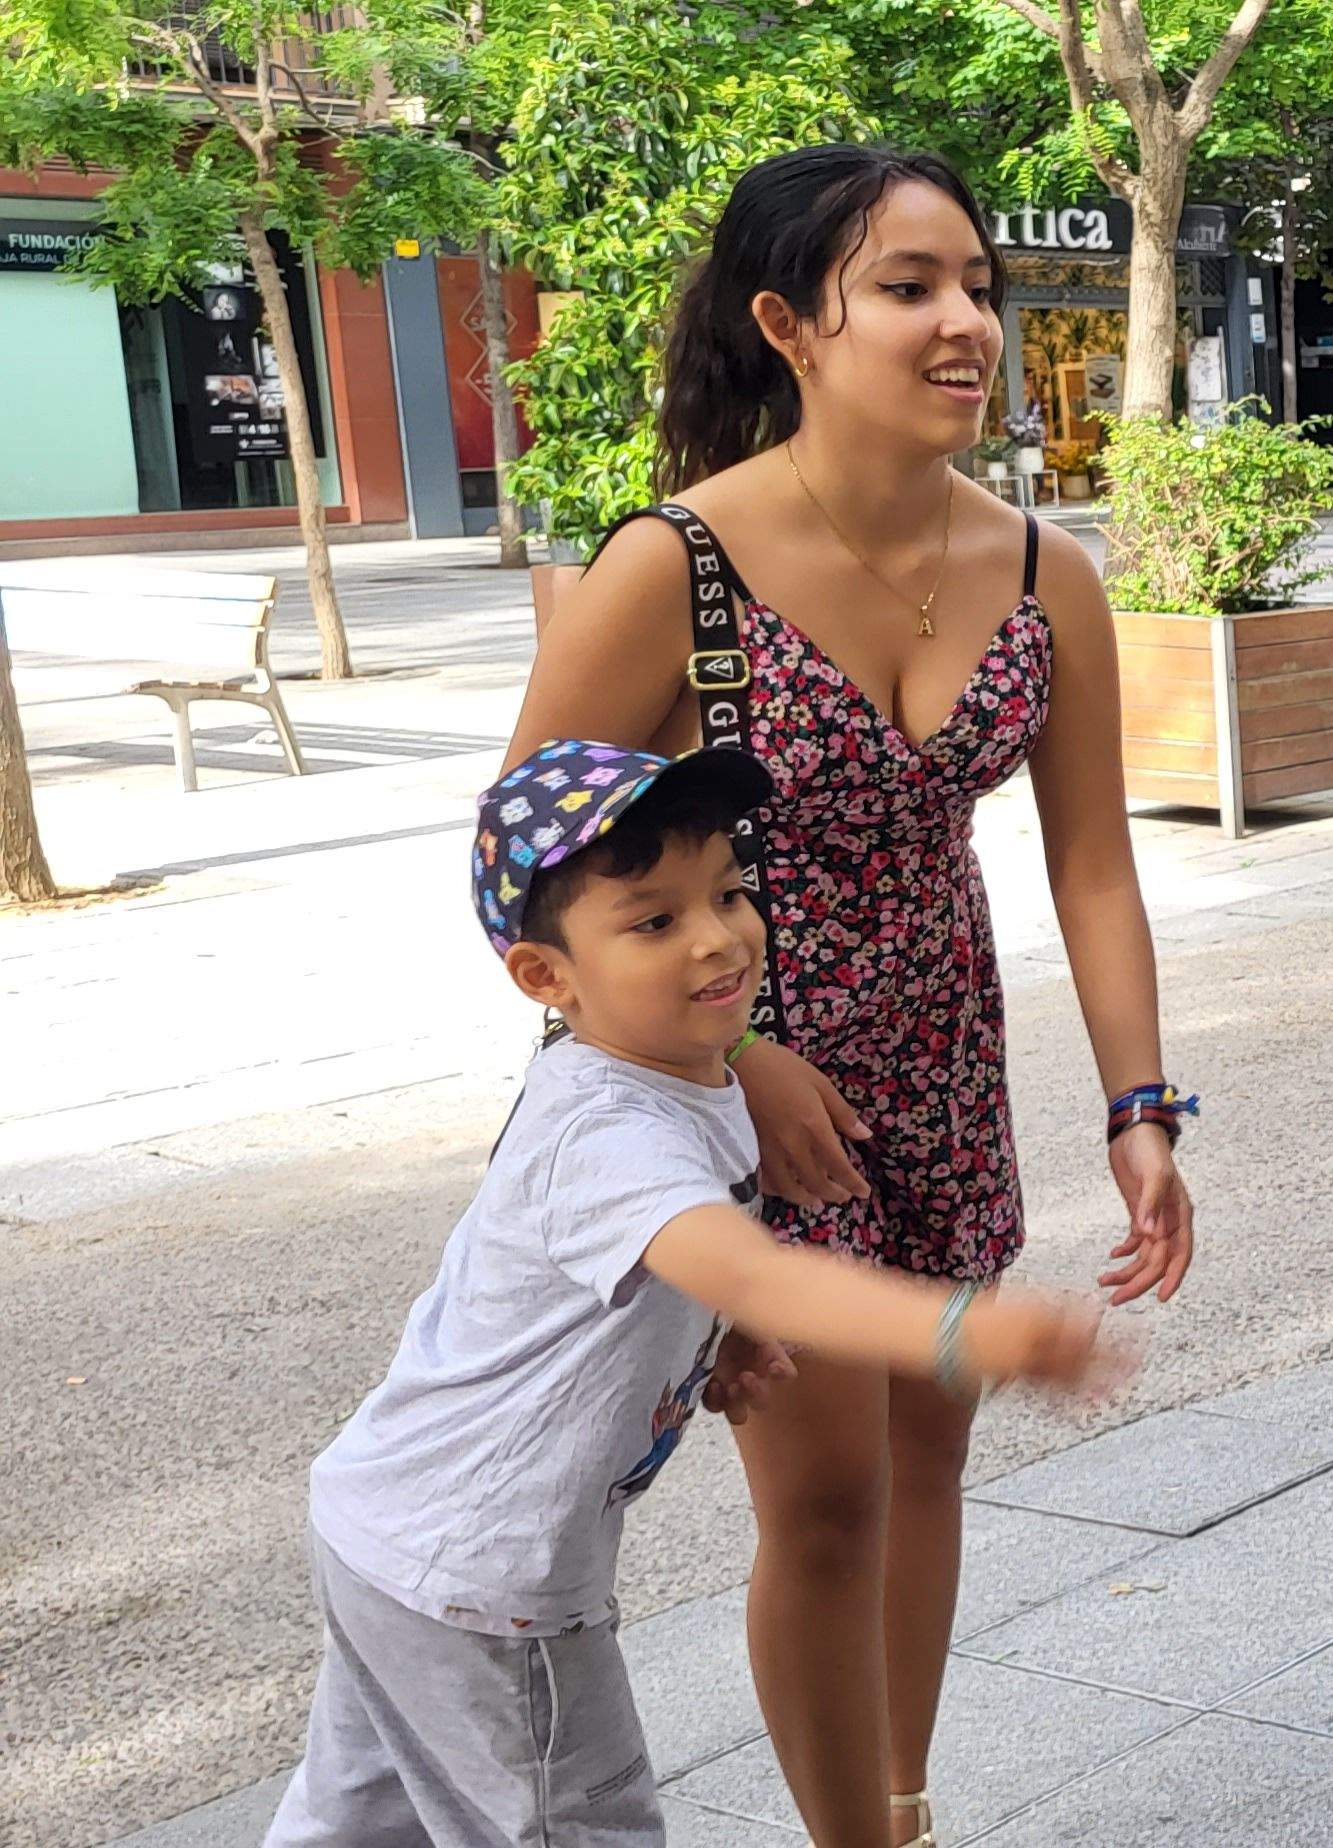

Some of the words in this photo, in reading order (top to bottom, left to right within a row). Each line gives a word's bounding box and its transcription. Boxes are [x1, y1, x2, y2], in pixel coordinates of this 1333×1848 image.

[990, 200, 1114, 251] rtica
[0, 252, 19, 264] JA
[20, 252, 61, 265] RURAL
[660, 506, 729, 629] GUESS
